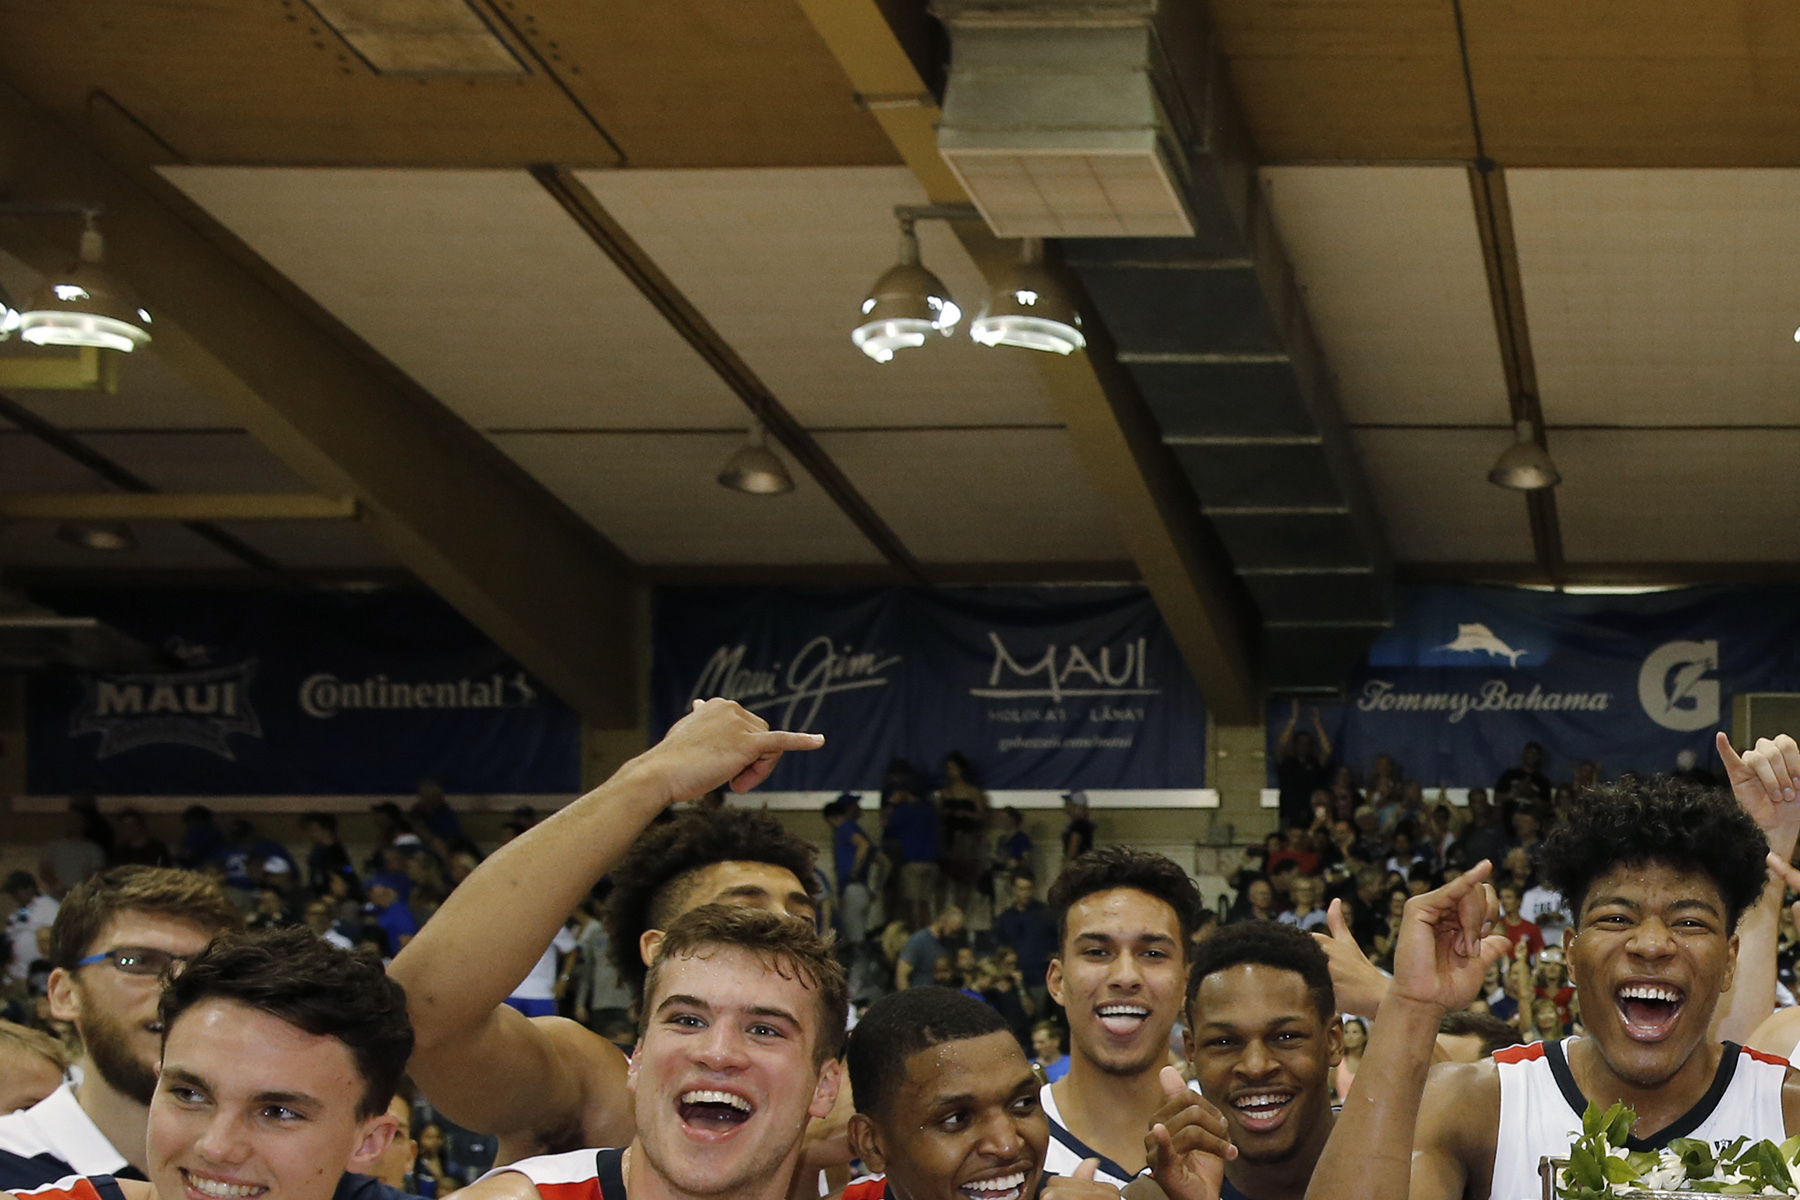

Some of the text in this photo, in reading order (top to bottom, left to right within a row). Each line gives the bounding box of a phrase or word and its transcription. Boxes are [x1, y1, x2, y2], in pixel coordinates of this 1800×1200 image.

[690, 636, 901, 733] Maui Jim
[987, 631, 1147, 703] MAUI
[94, 680, 238, 717] MAUI
[298, 673, 501, 719] Continental
[1357, 680, 1608, 724] Tommy Bahama
